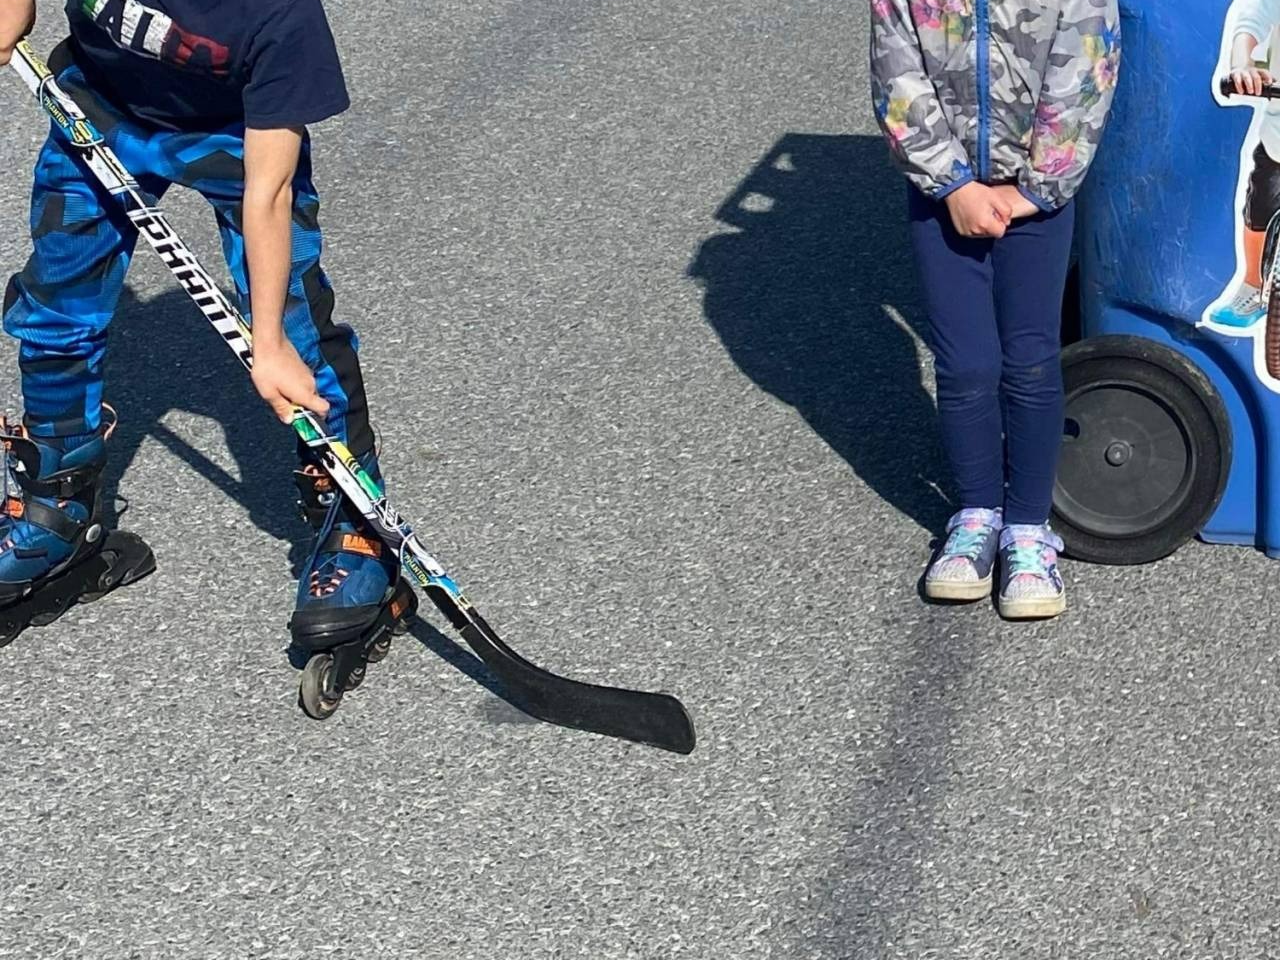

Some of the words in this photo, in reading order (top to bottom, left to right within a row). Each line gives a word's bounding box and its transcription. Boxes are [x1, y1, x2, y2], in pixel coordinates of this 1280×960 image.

[43, 95, 70, 129] PHANTOM
[132, 214, 253, 370] PHANT
[403, 553, 431, 587] PHANTOM
